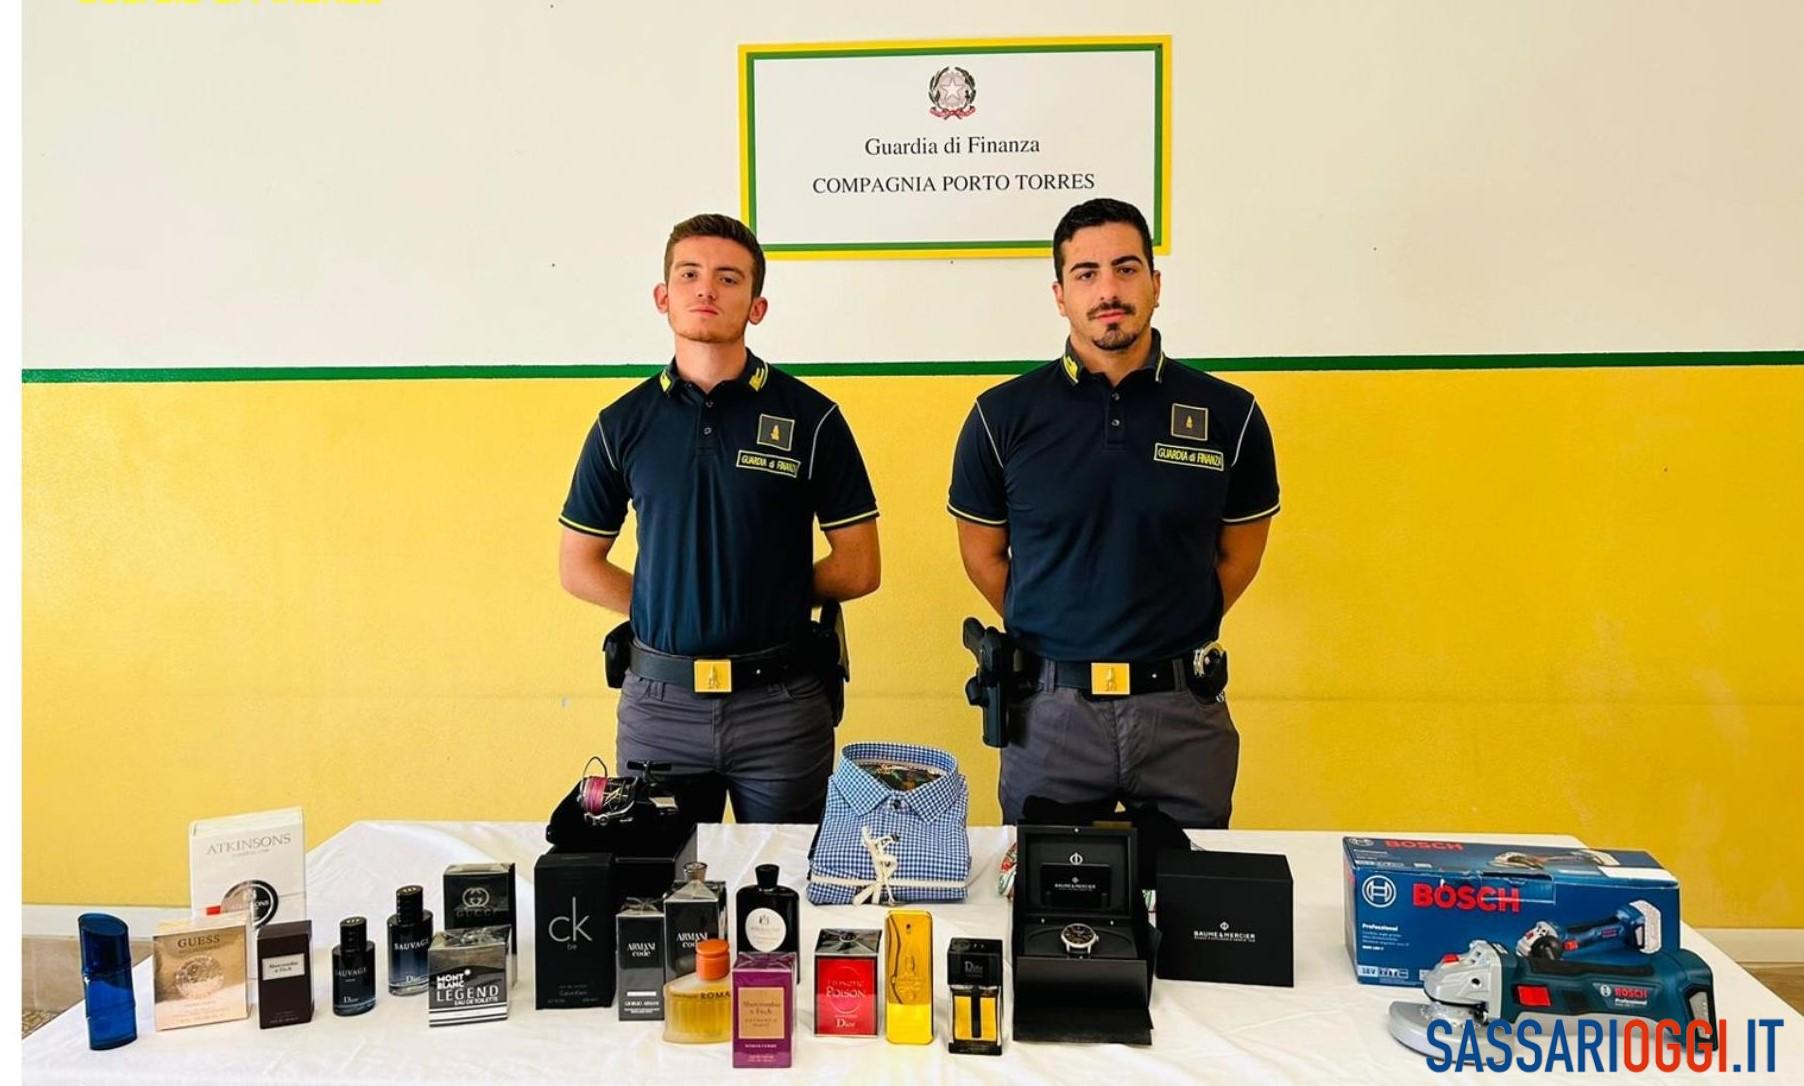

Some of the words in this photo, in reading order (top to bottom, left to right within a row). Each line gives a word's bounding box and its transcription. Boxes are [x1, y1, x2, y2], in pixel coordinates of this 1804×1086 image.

[865, 137, 938, 156] Guardia
[944, 137, 961, 154] di
[968, 136, 1040, 154] Finanza
[812, 175, 936, 194] COMPAGNIA
[943, 174, 1010, 192] PORTO
[1015, 173, 1095, 190] TORRES
[741, 454, 767, 467] GUARDIA
[1158, 447, 1188, 461] GUARDIA
[207, 833, 292, 855] ATKINSONS
[1384, 839, 1464, 851] BOSCH
[1412, 882, 1520, 912] BOSCH
[549, 896, 592, 942] ck
[177, 934, 221, 948] GUESS
[677, 932, 707, 941] ARMANI
[394, 938, 429, 951] SAUVAGE
[627, 942, 656, 951] ARMANI
[632, 949, 651, 957] code
[335, 967, 368, 977] SAUVAGE
[964, 961, 983, 974] Dior
[437, 973, 464, 982] MONT
[437, 981, 464, 990] BLANC
[437, 985, 499, 1002] LEGEND
[700, 991, 730, 1000] ROMA
[1615, 987, 1648, 998] BOSCH
[836, 1018, 856, 1028] Dior
